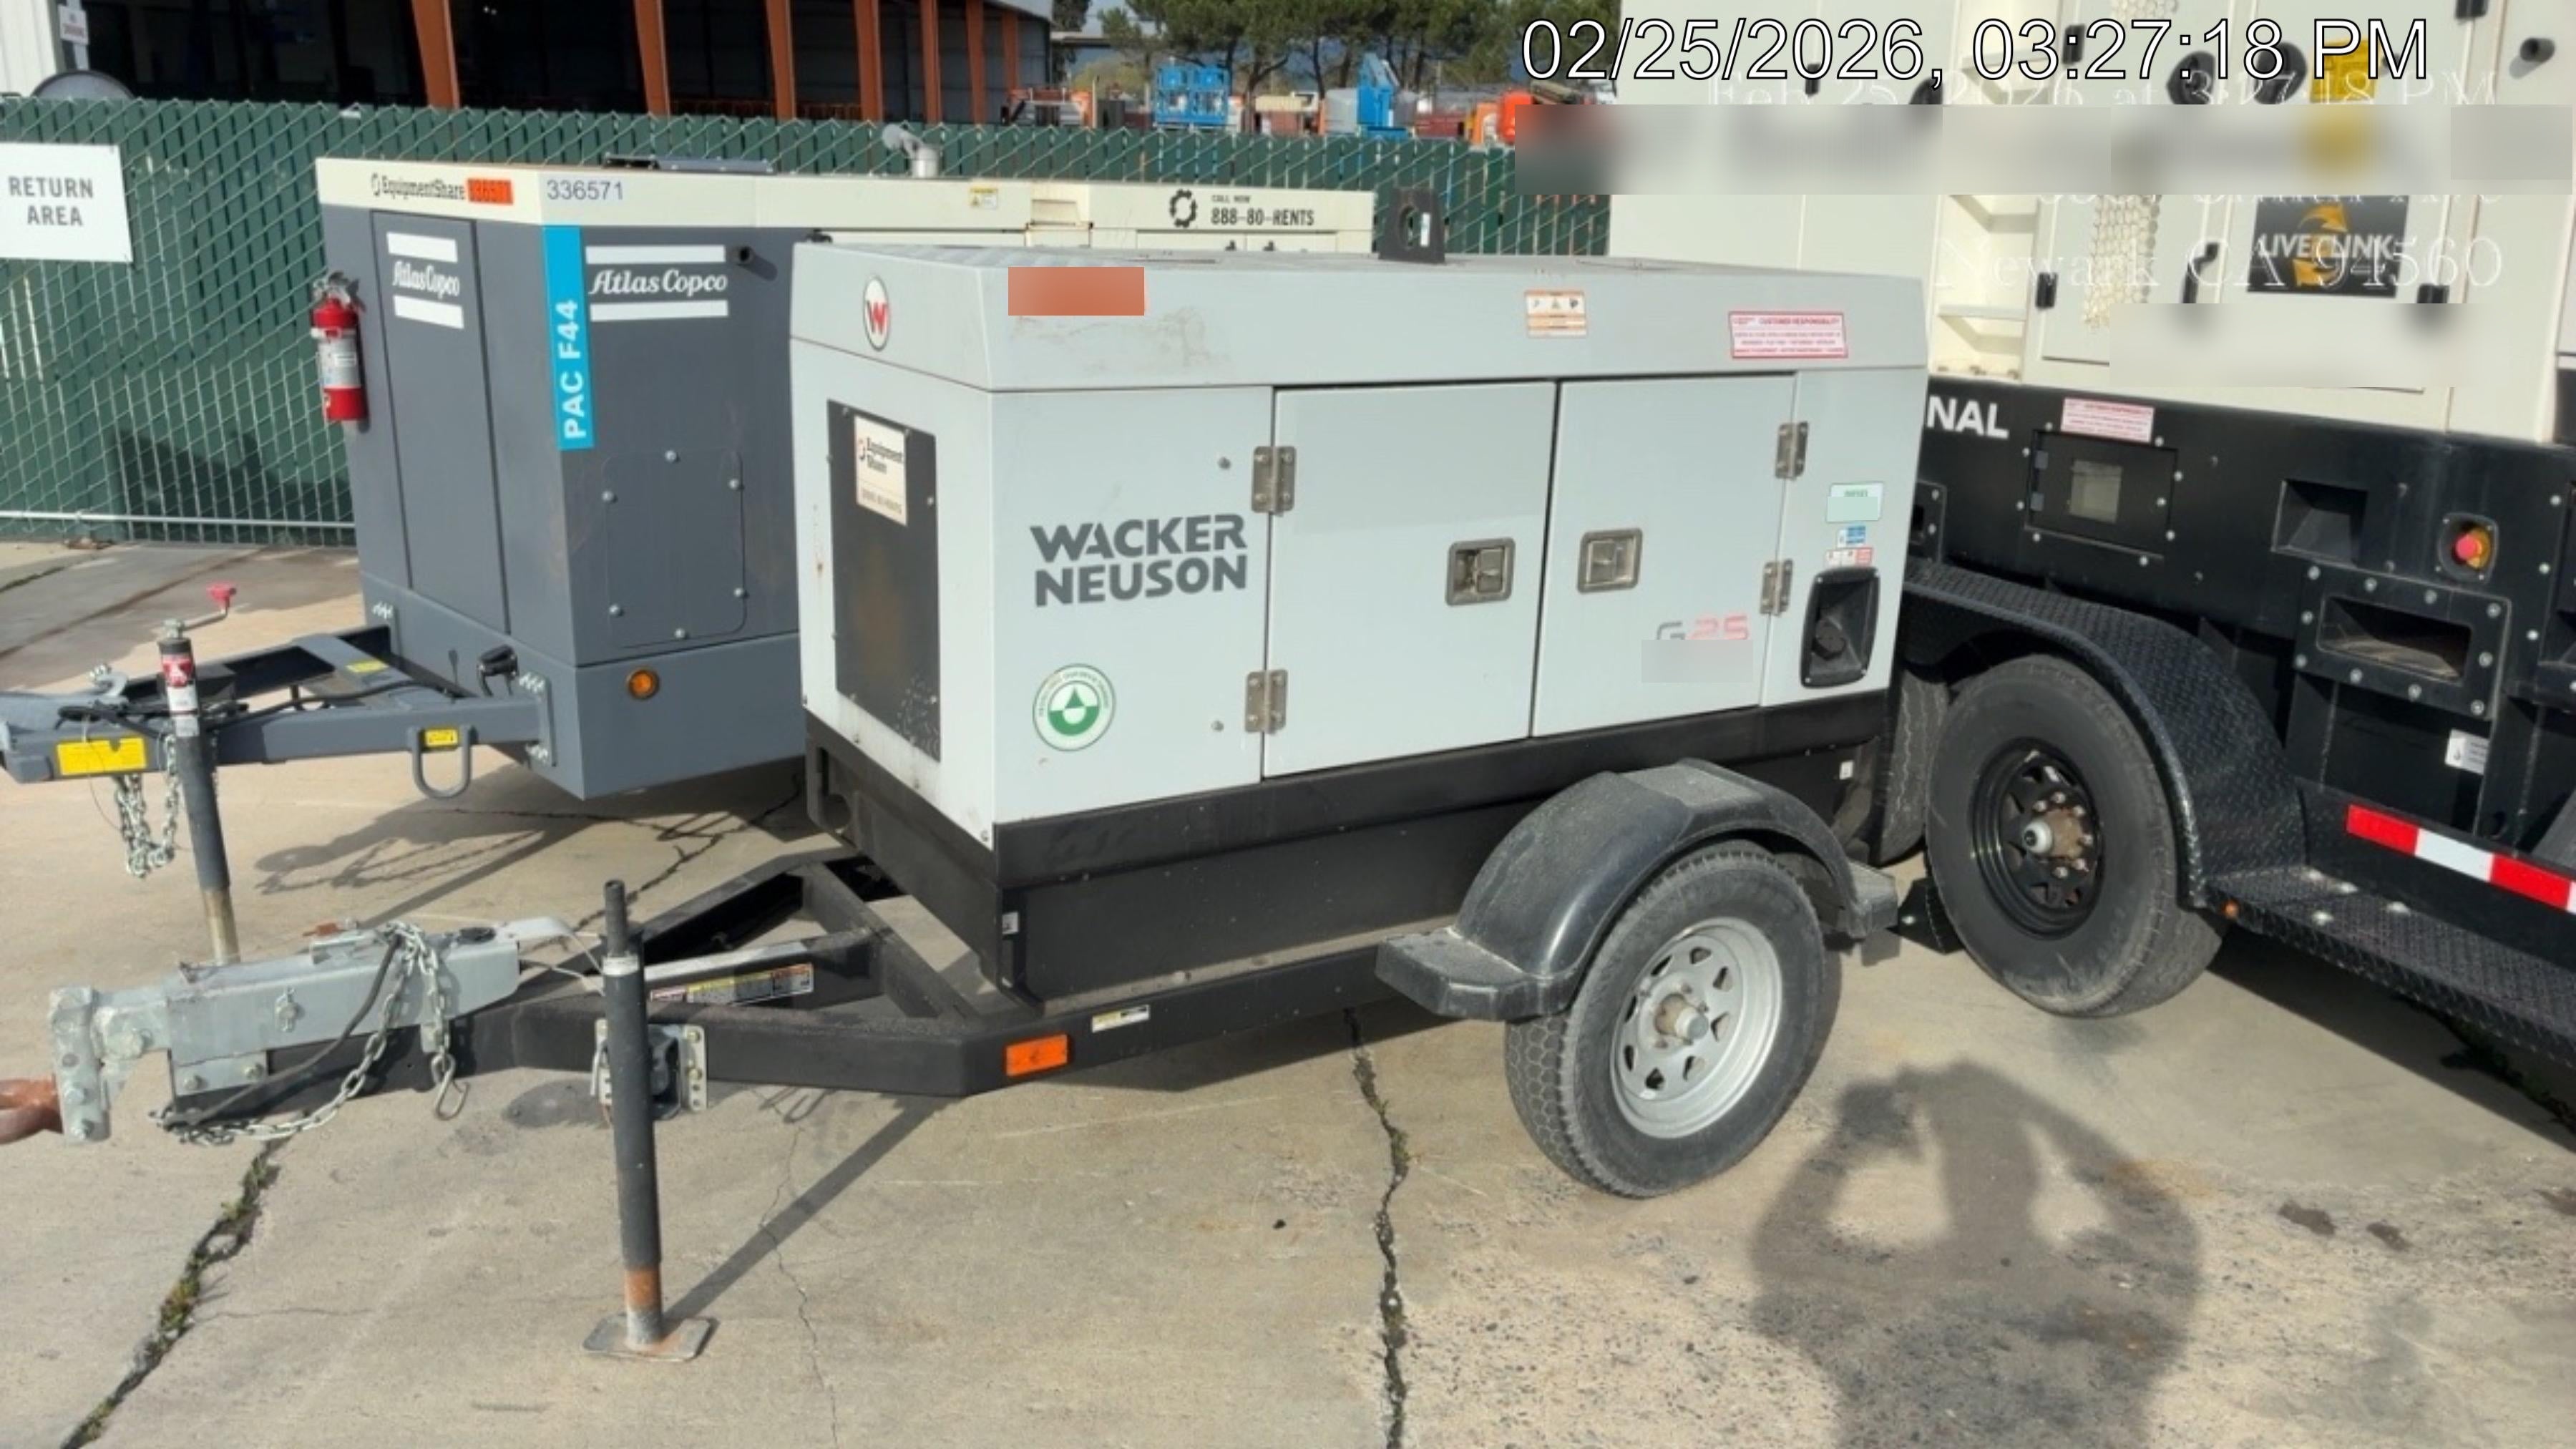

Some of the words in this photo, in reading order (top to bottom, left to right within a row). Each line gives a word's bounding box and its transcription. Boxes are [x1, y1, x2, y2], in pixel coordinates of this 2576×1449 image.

[8, 175, 94, 199] RETURN
[546, 179, 625, 200] 336571
[27, 205, 84, 227] AREA
[1211, 208, 1315, 226] 888-80-RENTS
[555, 299, 582, 359] F44
[560, 371, 587, 440] PAC
[1029, 513, 1248, 563] WACKER
[1035, 553, 1248, 608] NEUSON
